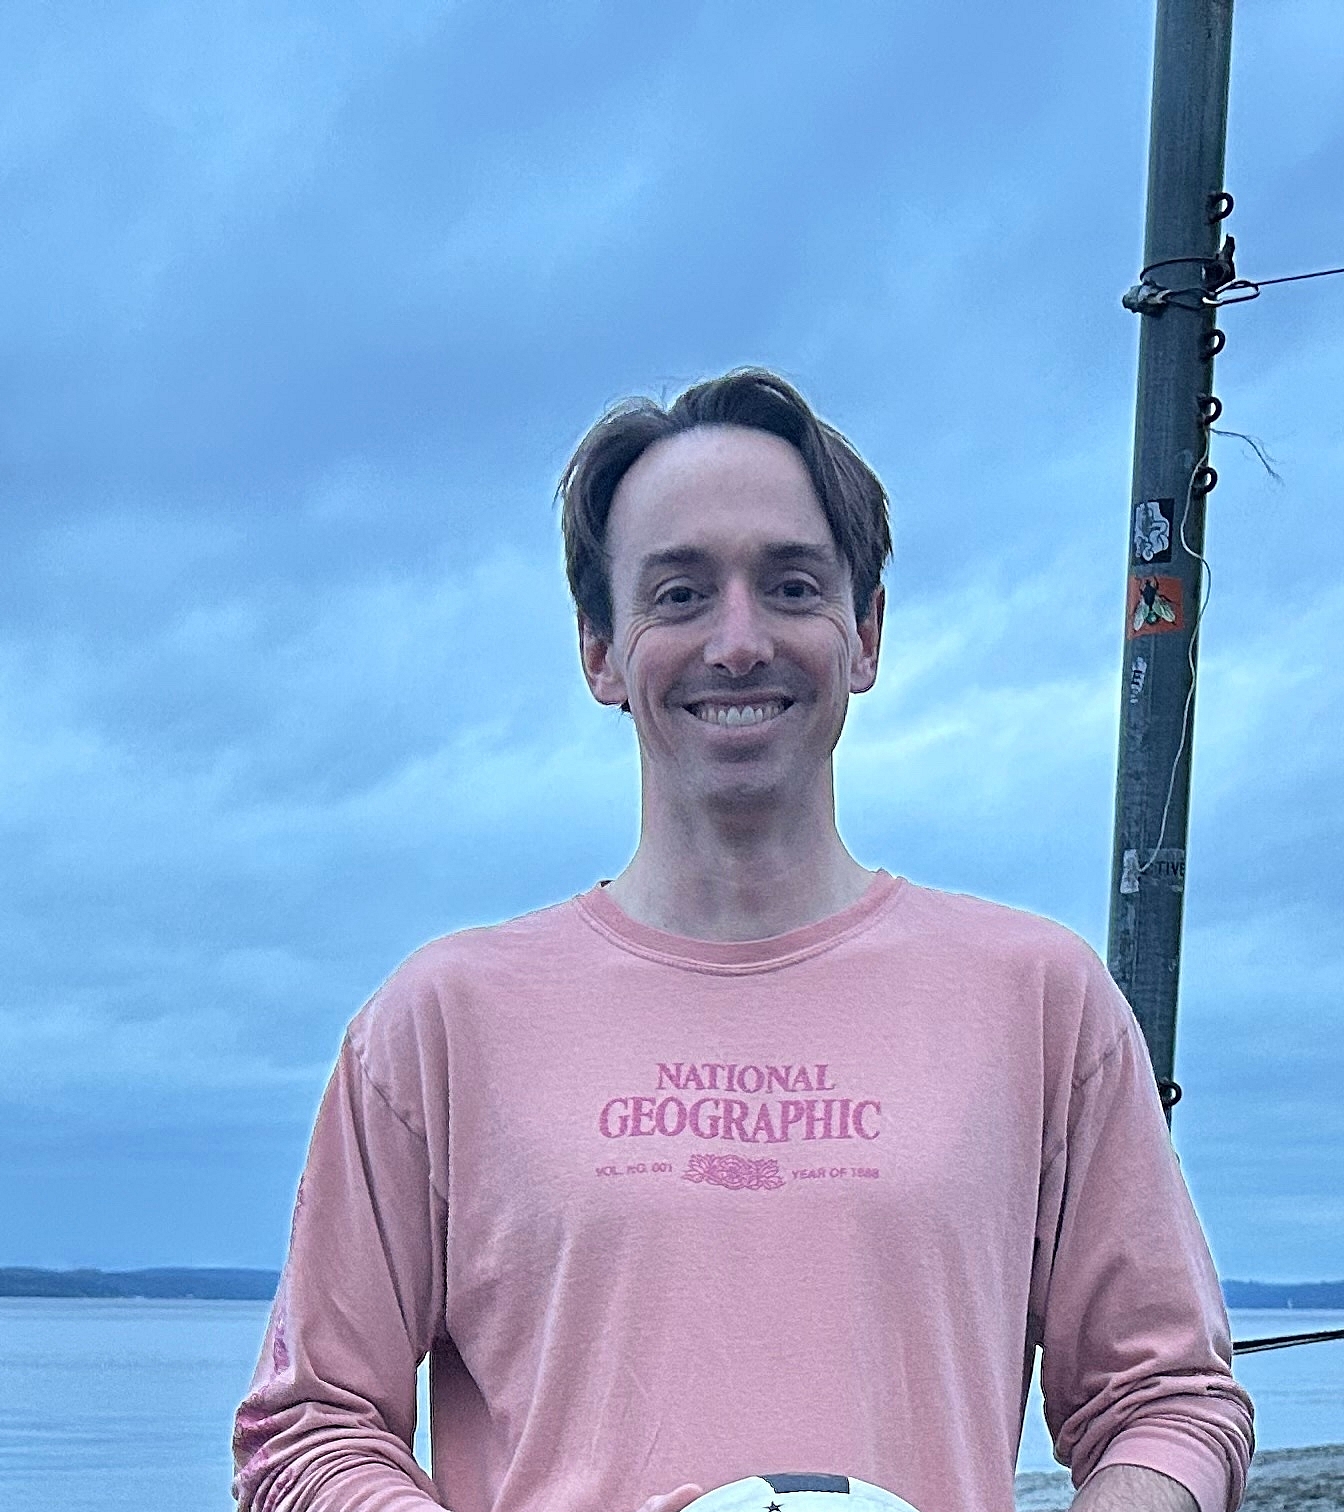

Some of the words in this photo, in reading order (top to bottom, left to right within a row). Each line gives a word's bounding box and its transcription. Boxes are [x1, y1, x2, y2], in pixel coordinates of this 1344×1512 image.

[655, 1062, 836, 1094] NATIONAL
[598, 1096, 882, 1143] GEOGRAPHIC
[792, 1167, 826, 1180] YEAR
[829, 1167, 847, 1178] OF
